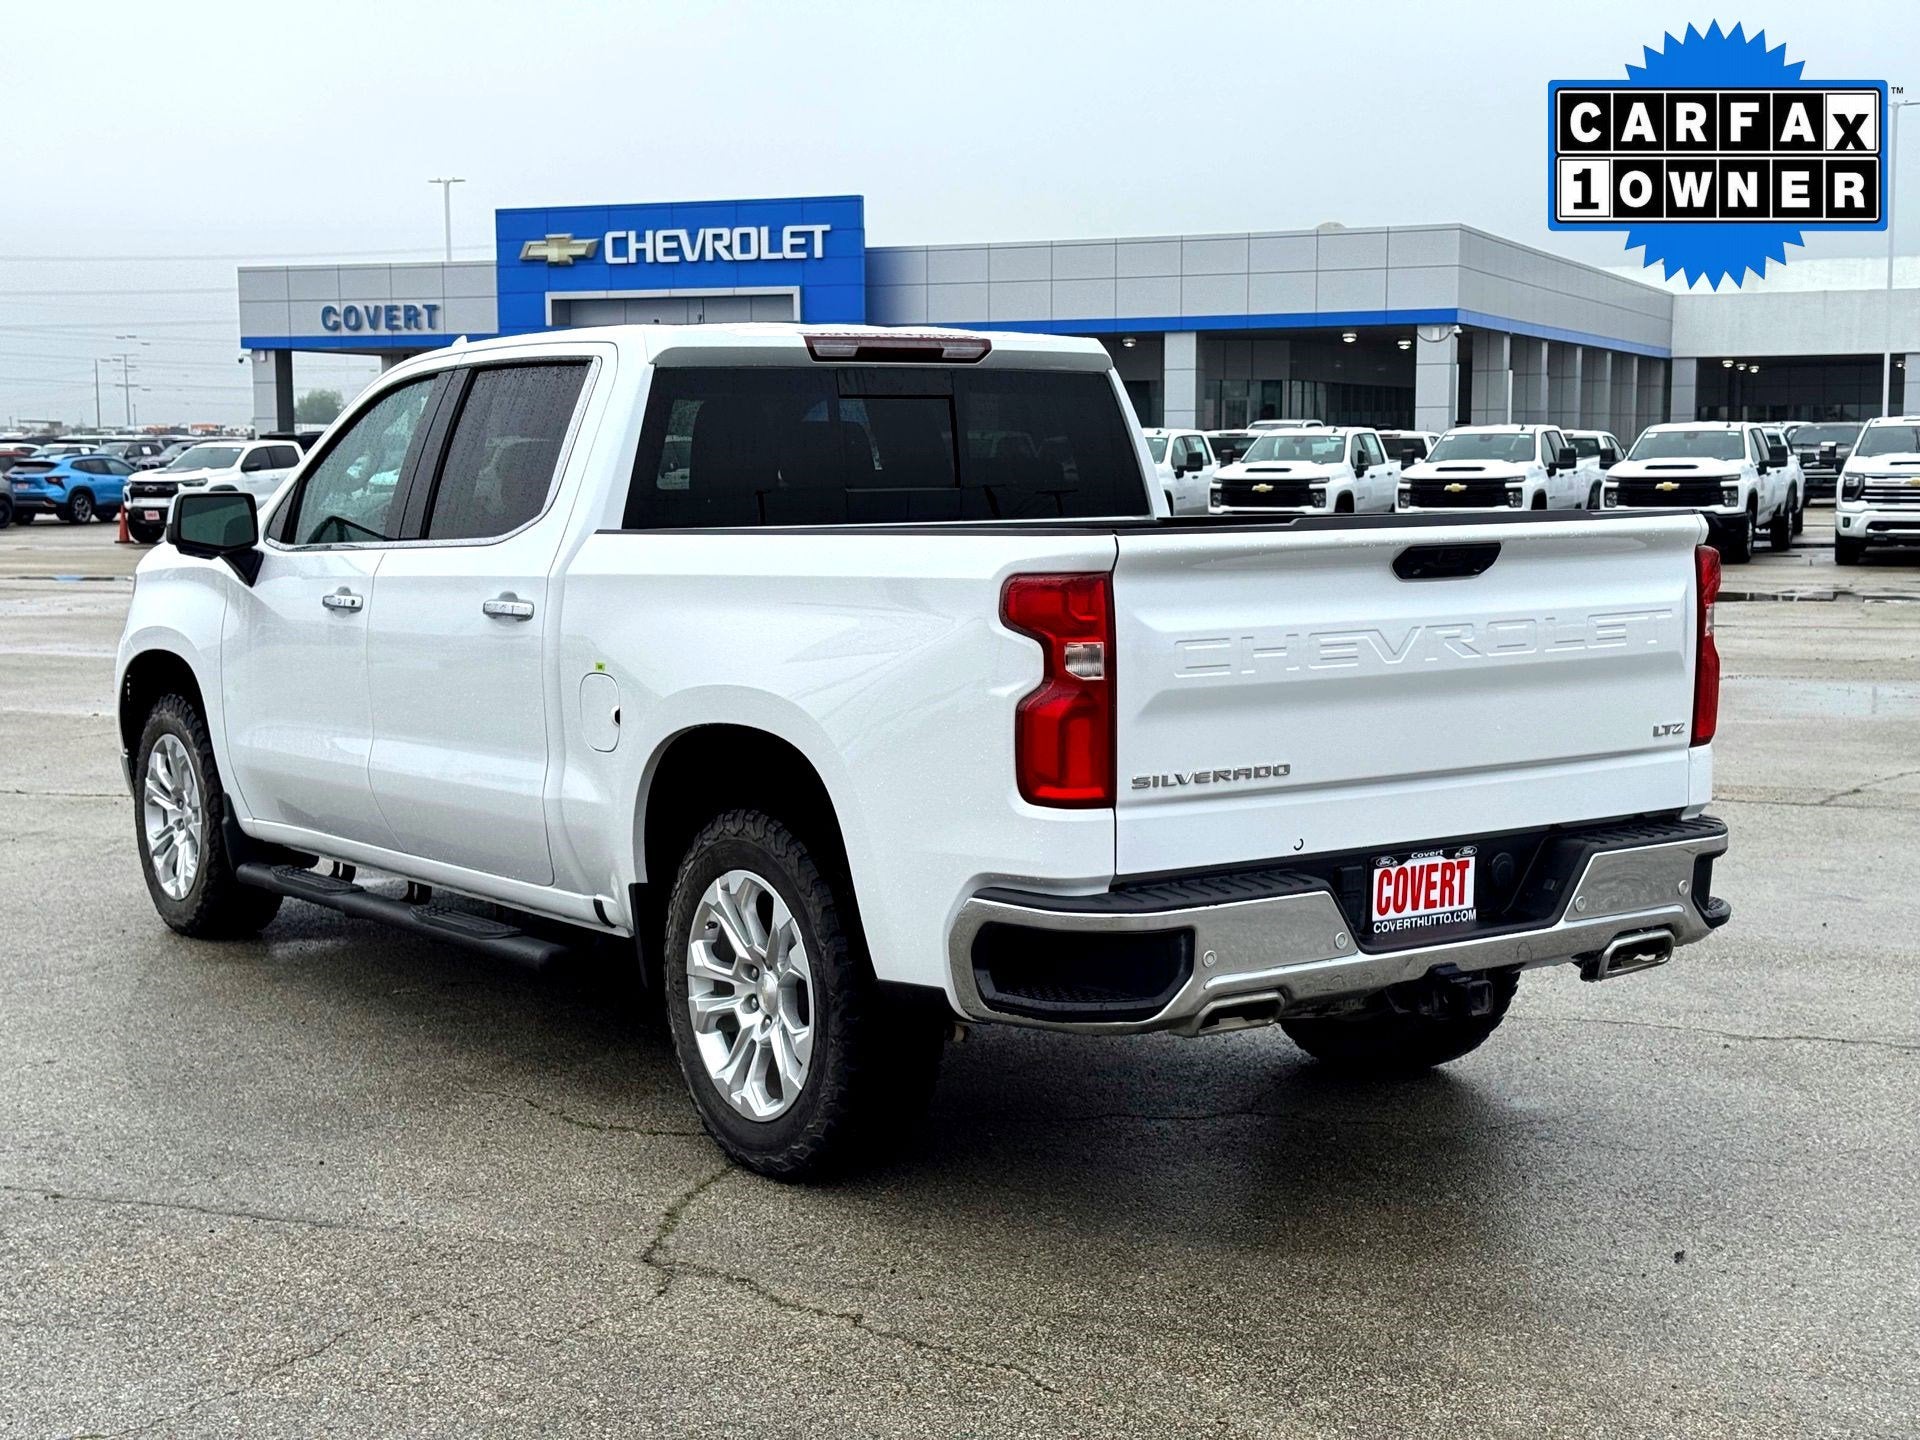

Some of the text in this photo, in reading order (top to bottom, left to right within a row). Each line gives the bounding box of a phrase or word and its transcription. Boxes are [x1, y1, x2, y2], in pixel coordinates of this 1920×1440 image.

[604, 224, 831, 264] CHEVROLET
[321, 304, 440, 331] COVERT
[1174, 609, 1673, 679] CHEVROLET
[1653, 722, 1686, 738] LTZ
[1131, 763, 1291, 790] SILVERADO
[1411, 849, 1444, 859] Covert
[1376, 859, 1470, 916] COVERT
[1373, 908, 1477, 934] COVERTHUTTO.COM
